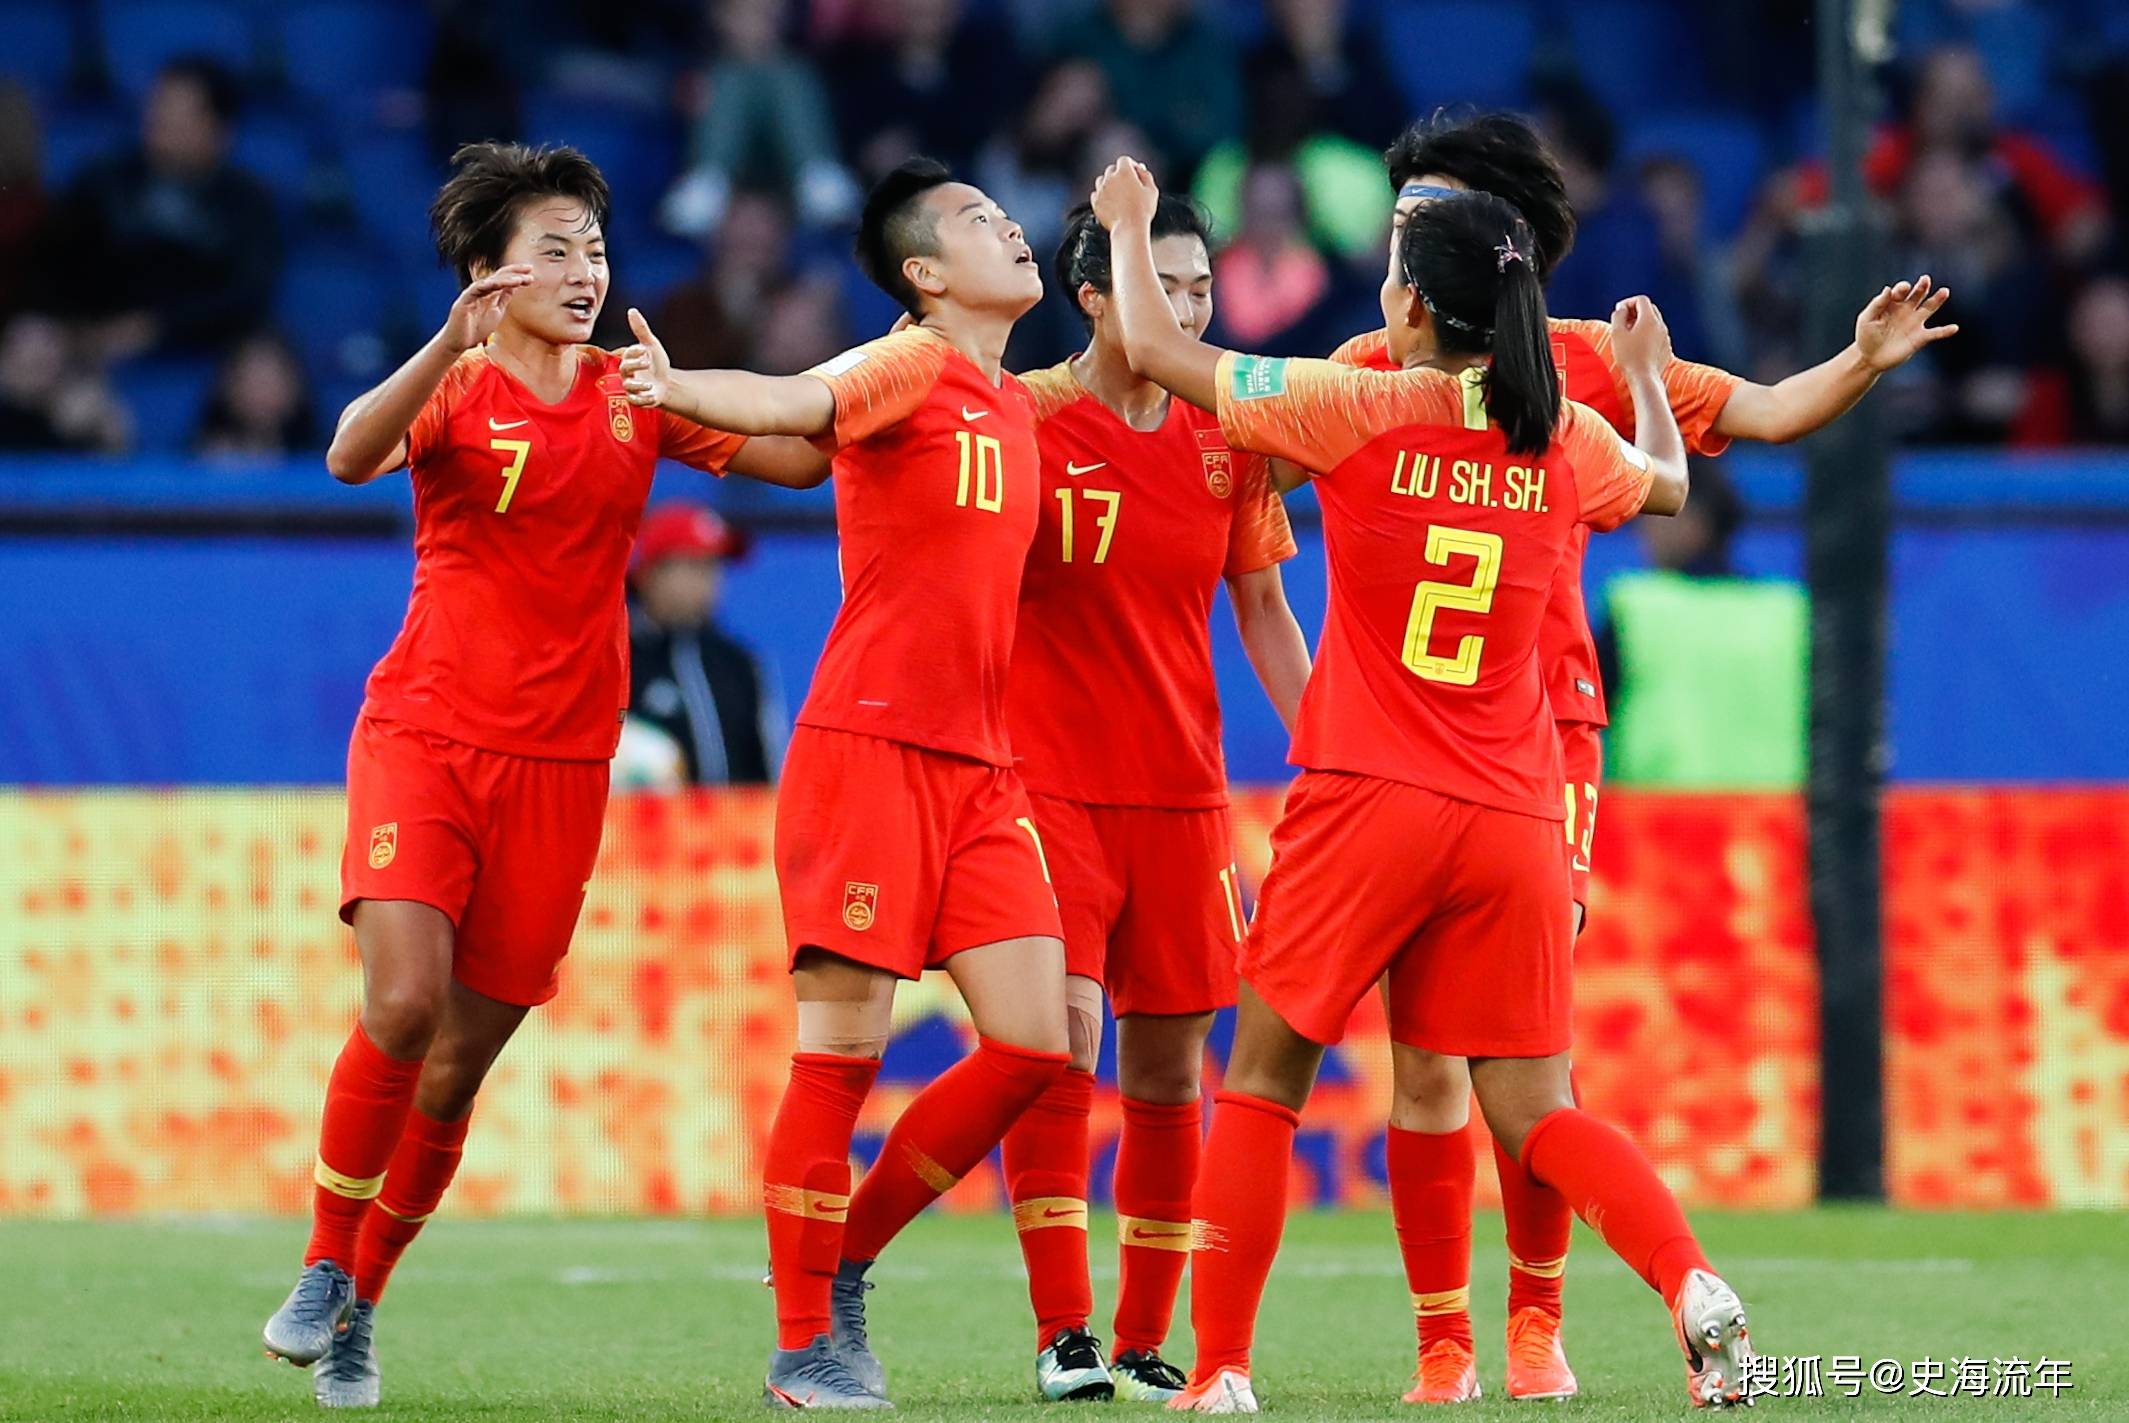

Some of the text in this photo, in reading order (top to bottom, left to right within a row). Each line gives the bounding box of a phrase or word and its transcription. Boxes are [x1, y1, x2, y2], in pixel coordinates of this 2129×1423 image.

[490, 438, 531, 514] 7
[955, 430, 1003, 514] 10
[1205, 455, 1229, 465] CFA
[1390, 450, 1441, 499] LIU
[1055, 487, 1121, 564] 17
[1401, 524, 1503, 686] 2
[848, 885, 875, 896] CFA
